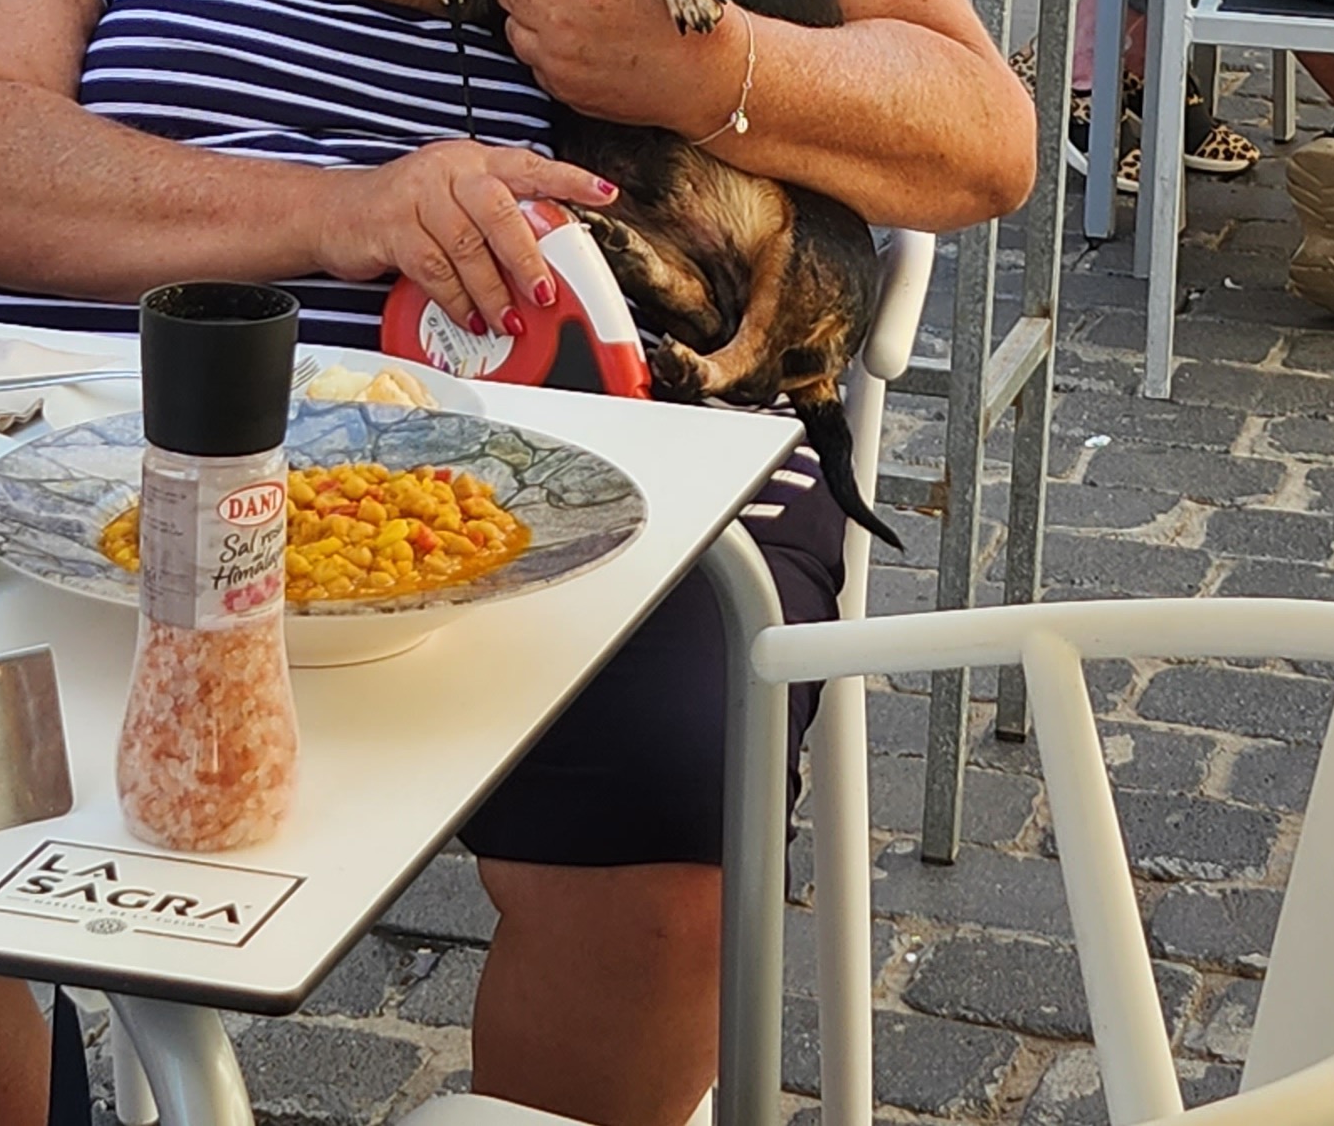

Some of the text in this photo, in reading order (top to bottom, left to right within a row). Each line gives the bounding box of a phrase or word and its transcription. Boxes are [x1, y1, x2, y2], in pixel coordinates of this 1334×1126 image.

[228, 489, 277, 520] DANI
[219, 528, 259, 564] Sal
[37, 853, 119, 882] LA
[16, 874, 241, 925] SAGRA
